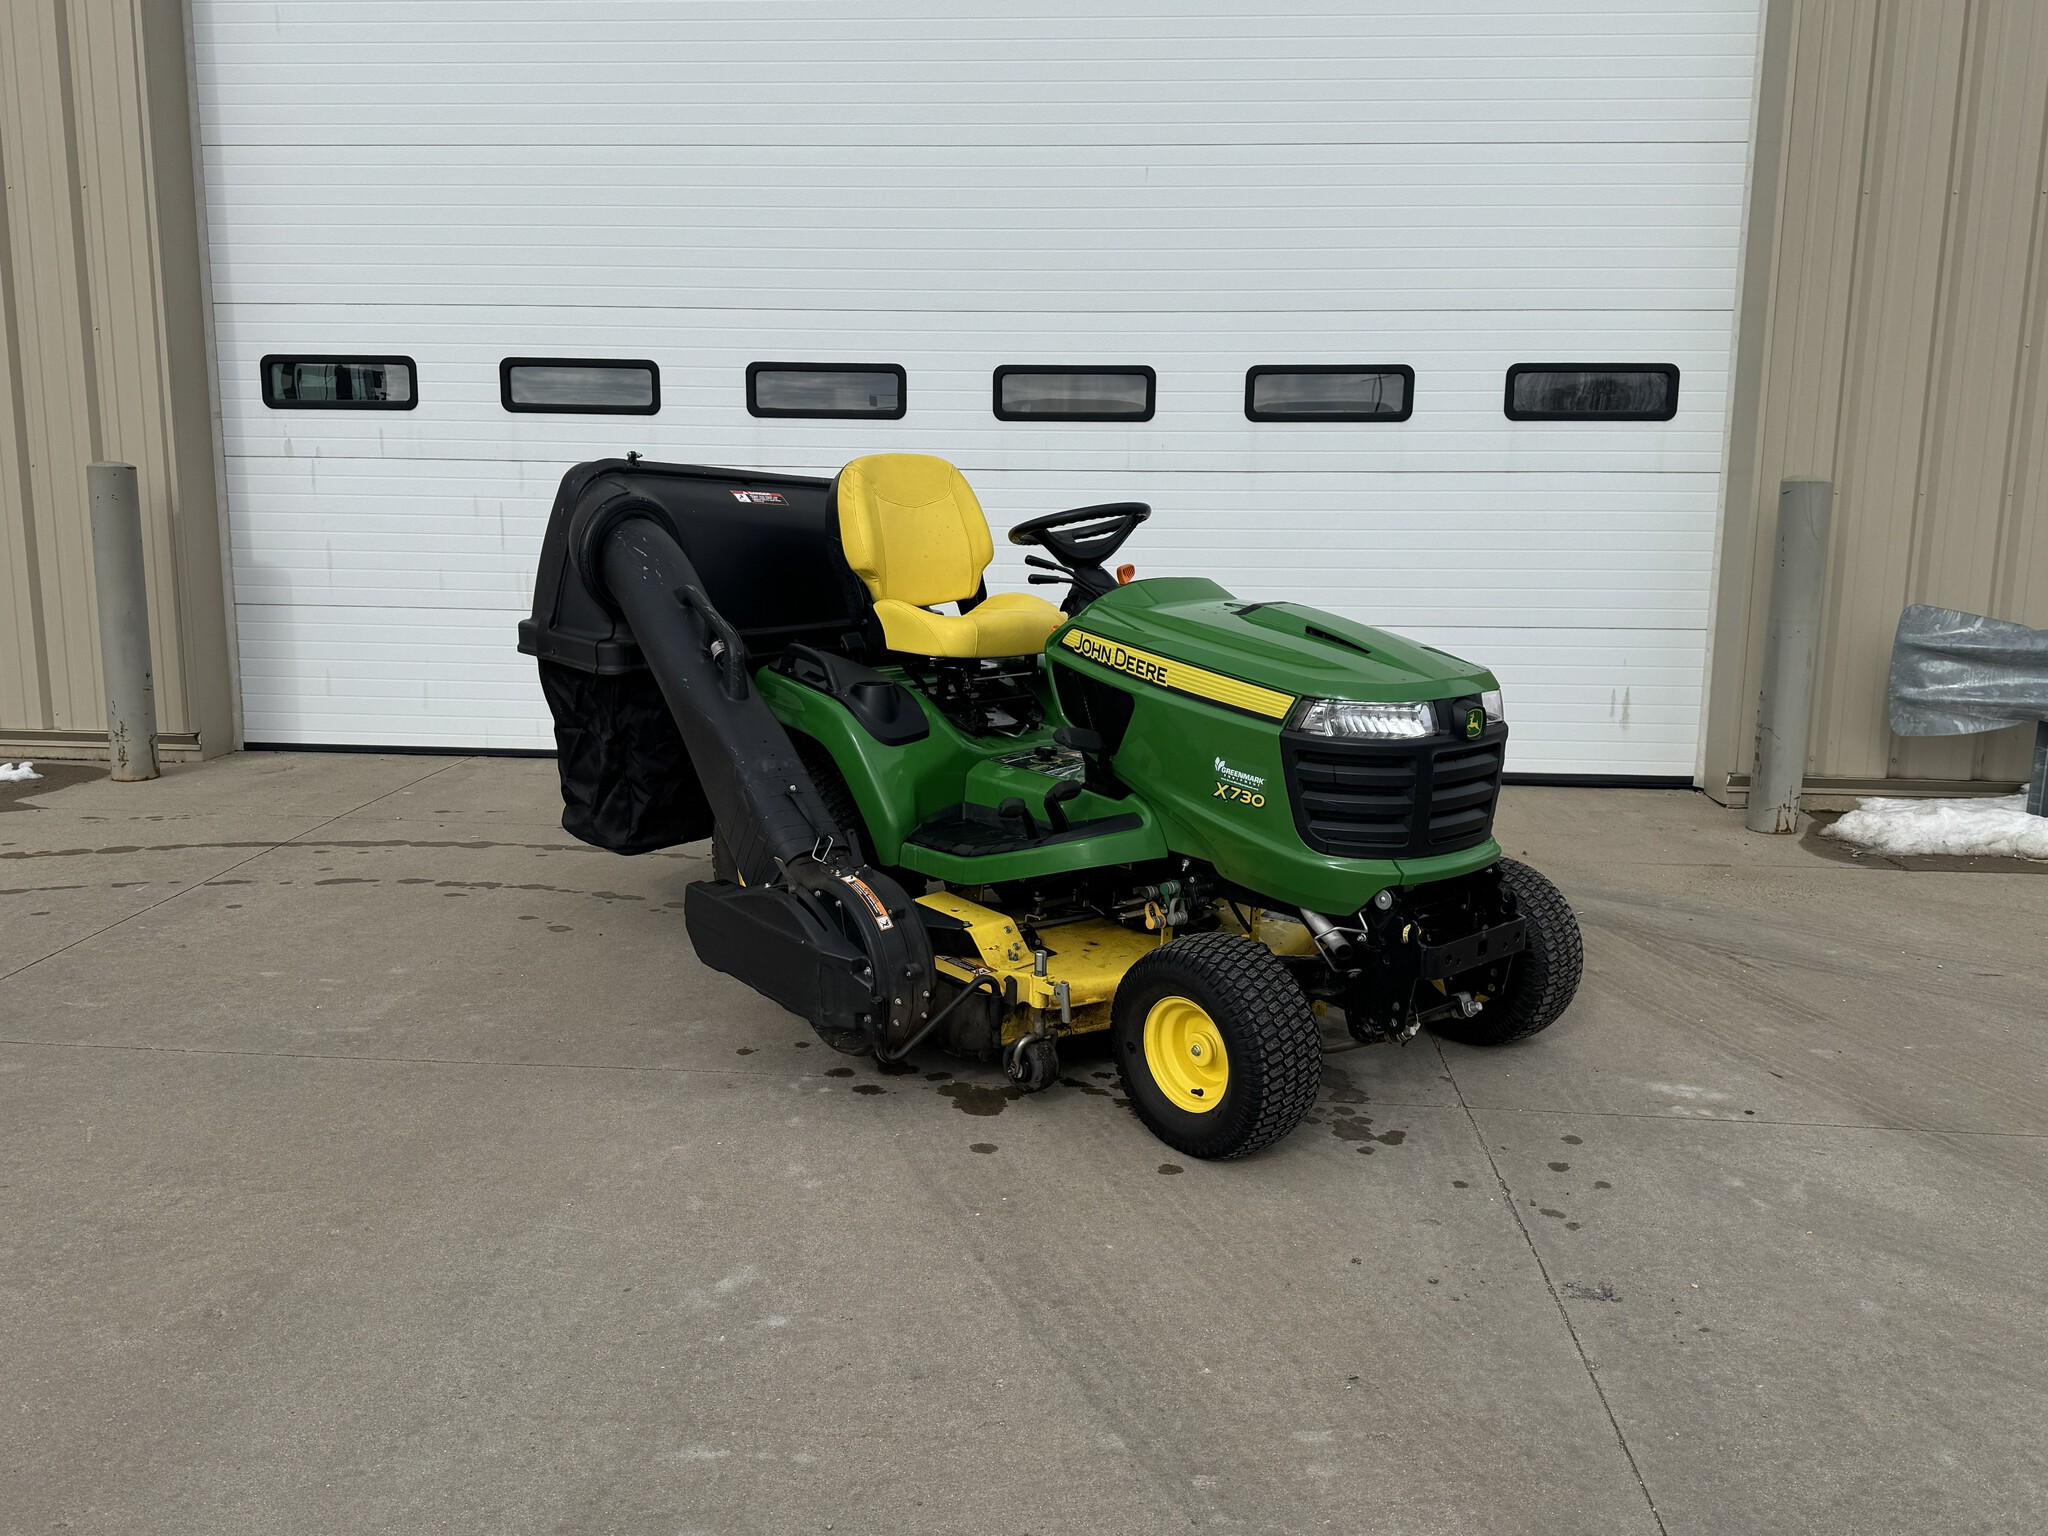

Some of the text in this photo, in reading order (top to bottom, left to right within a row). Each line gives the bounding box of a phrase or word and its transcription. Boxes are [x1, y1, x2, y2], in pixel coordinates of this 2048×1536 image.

[1074, 633, 1168, 684] JOHN DEERE
[1221, 766, 1264, 785] GREENMARK
[1212, 781, 1266, 808] X730
